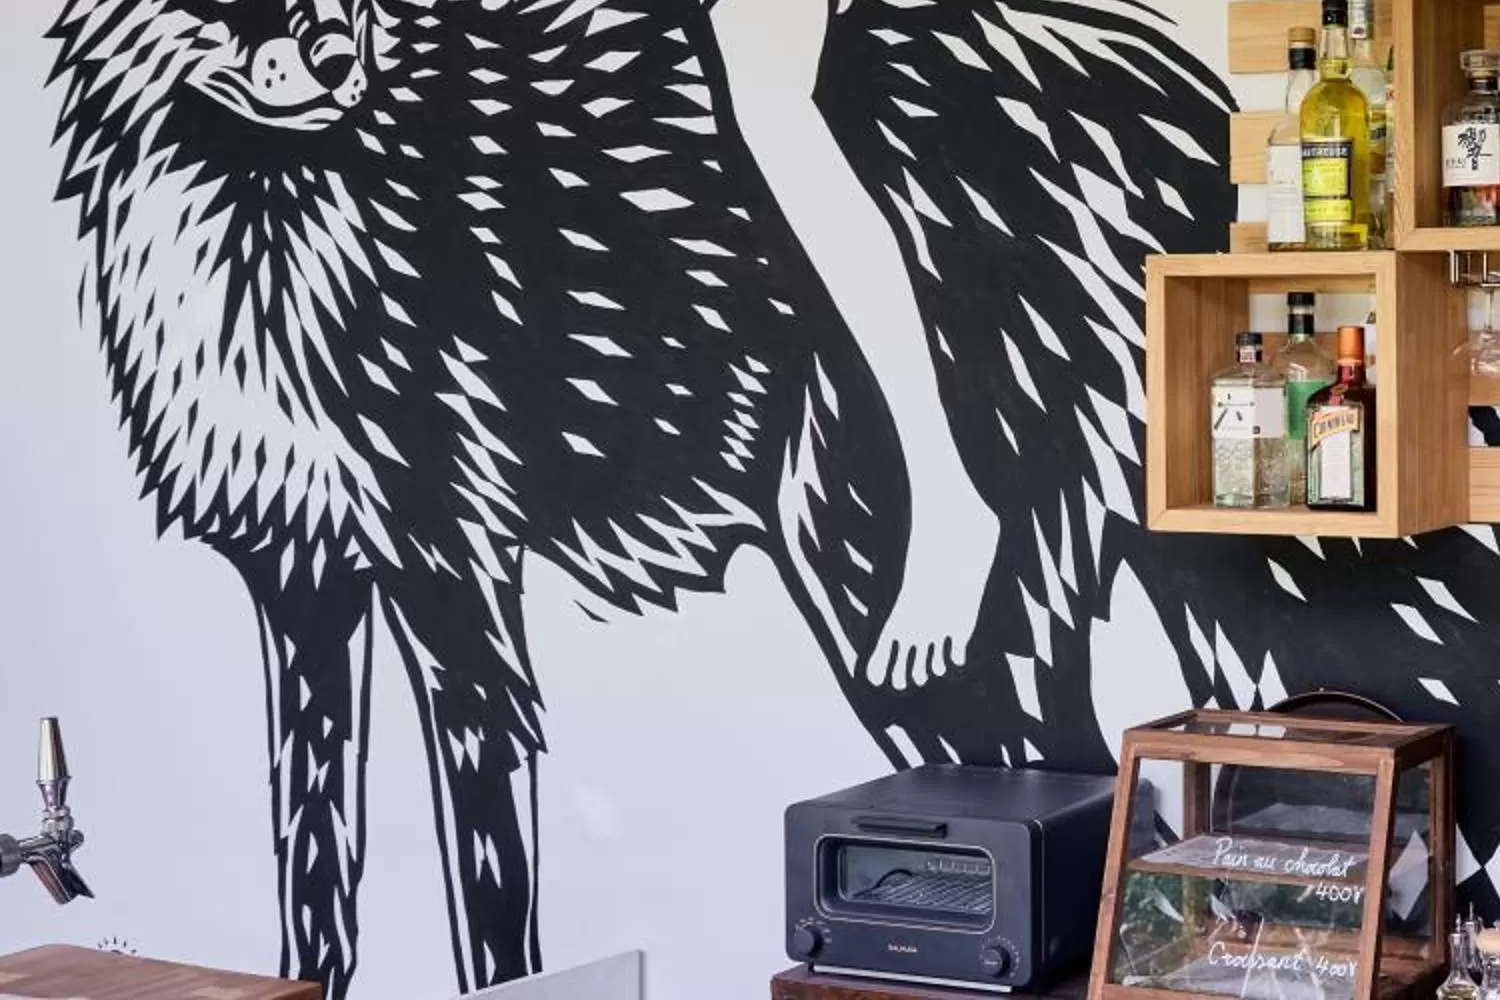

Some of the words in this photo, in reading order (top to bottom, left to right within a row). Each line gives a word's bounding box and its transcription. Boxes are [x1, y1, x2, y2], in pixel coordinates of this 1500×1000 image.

[1213, 836, 1248, 866] Pain
[1254, 856, 1278, 870] au
[1284, 847, 1357, 878] chocolat
